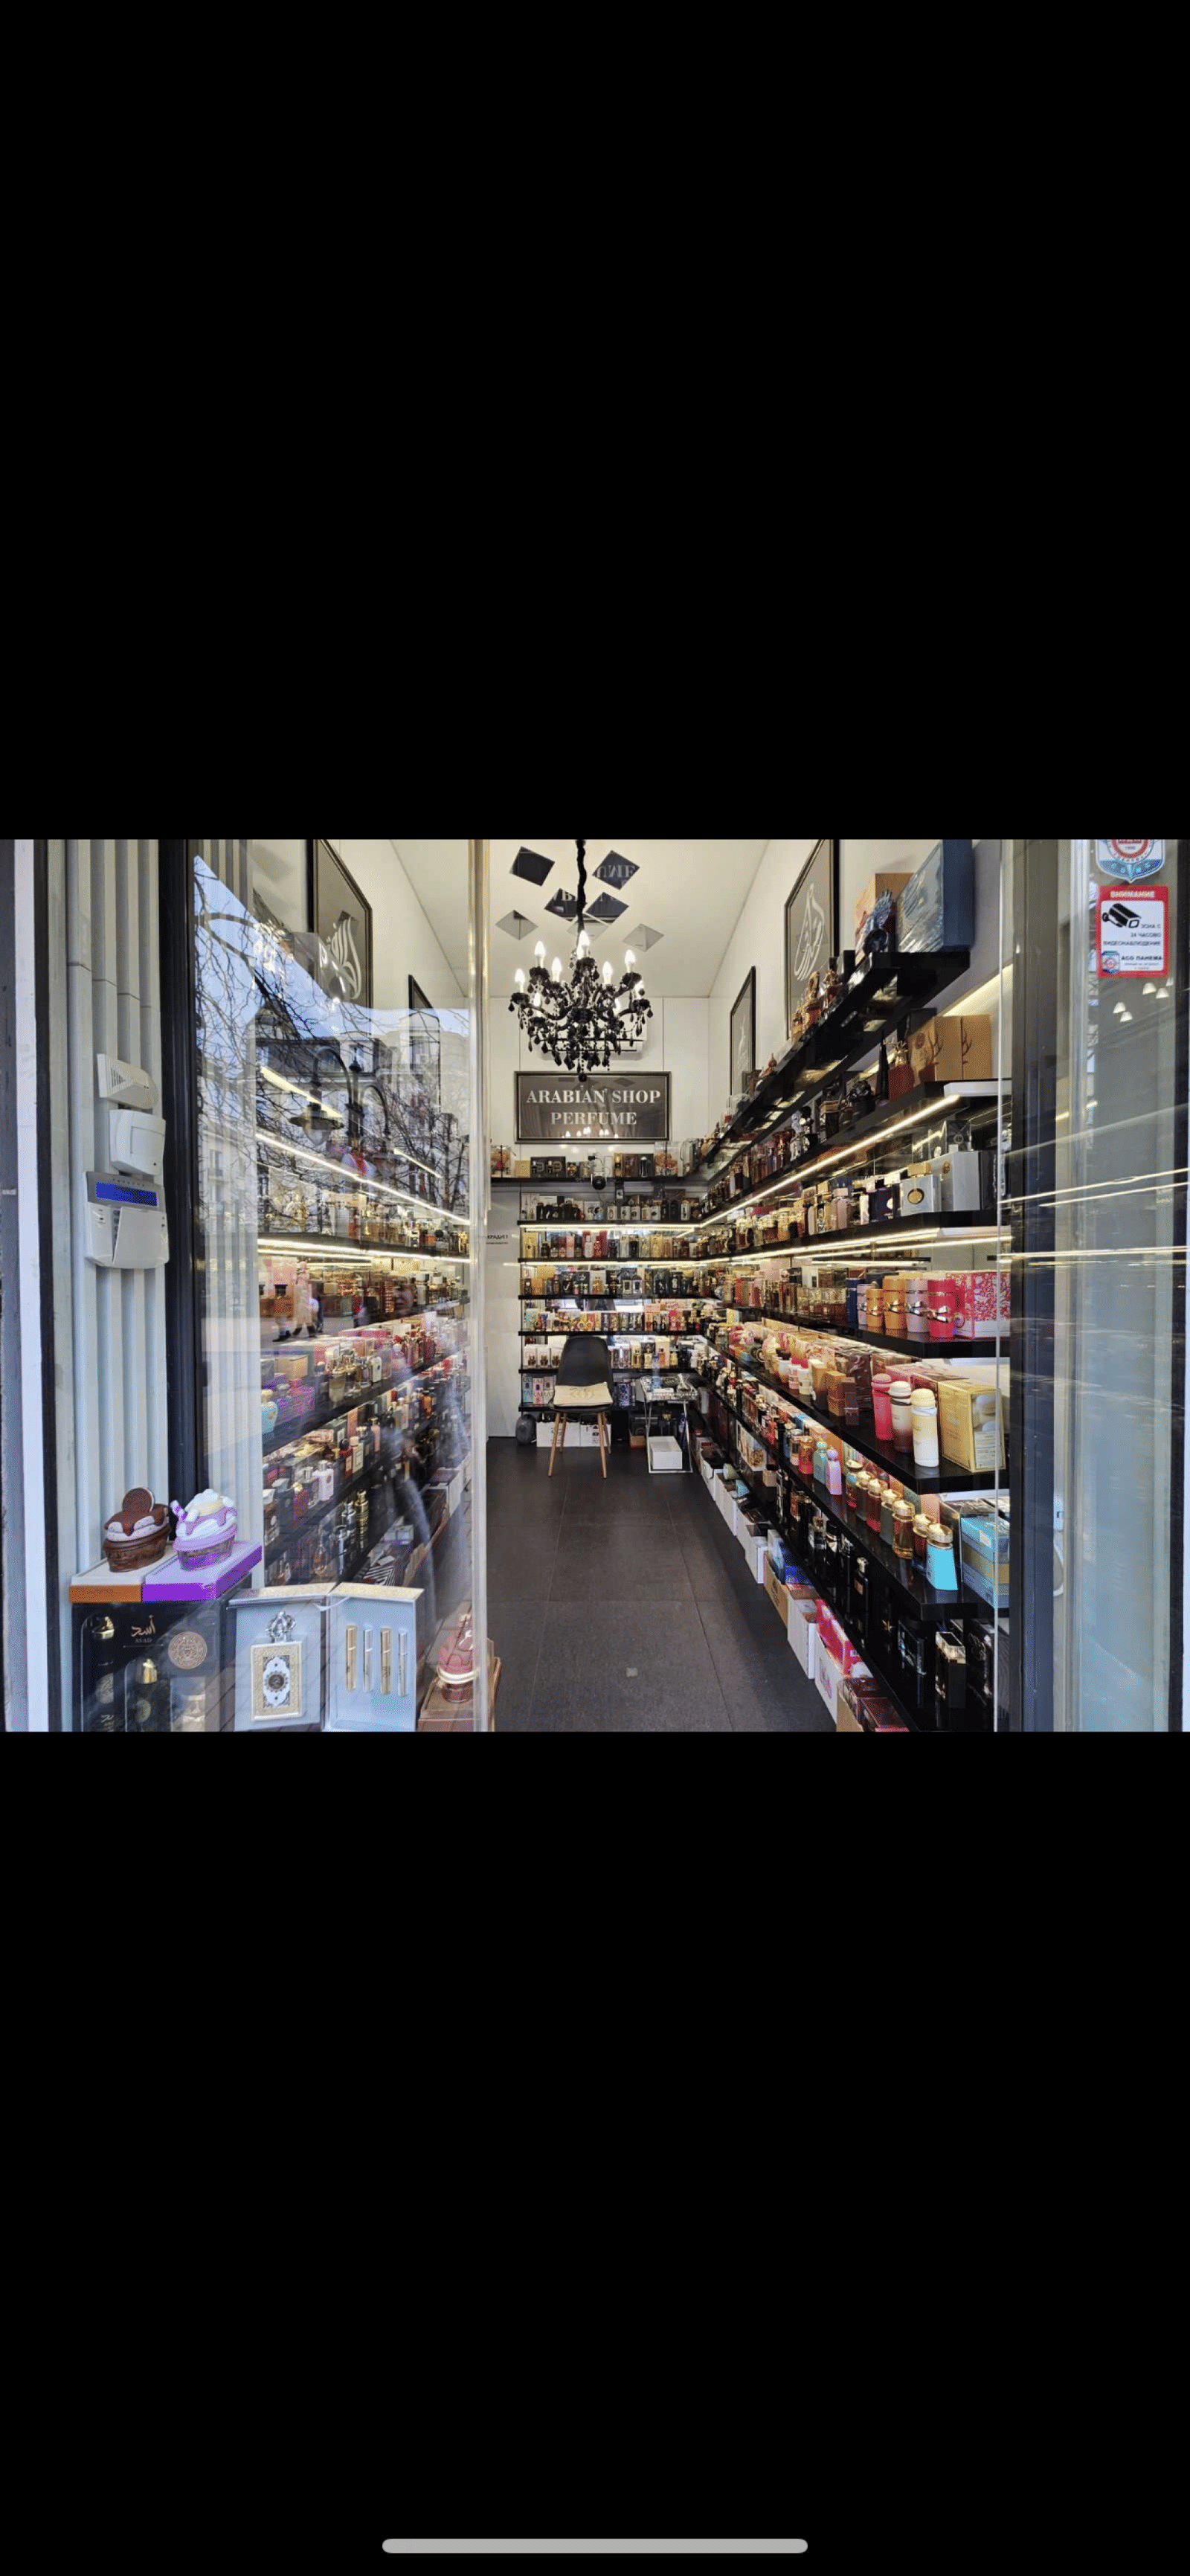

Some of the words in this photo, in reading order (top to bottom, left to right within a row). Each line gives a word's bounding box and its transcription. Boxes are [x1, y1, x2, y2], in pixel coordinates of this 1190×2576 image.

[527, 1090, 605, 1103] ARABIAN
[611, 1090, 660, 1103] SHOP
[550, 1112, 637, 1125] PERFUME
